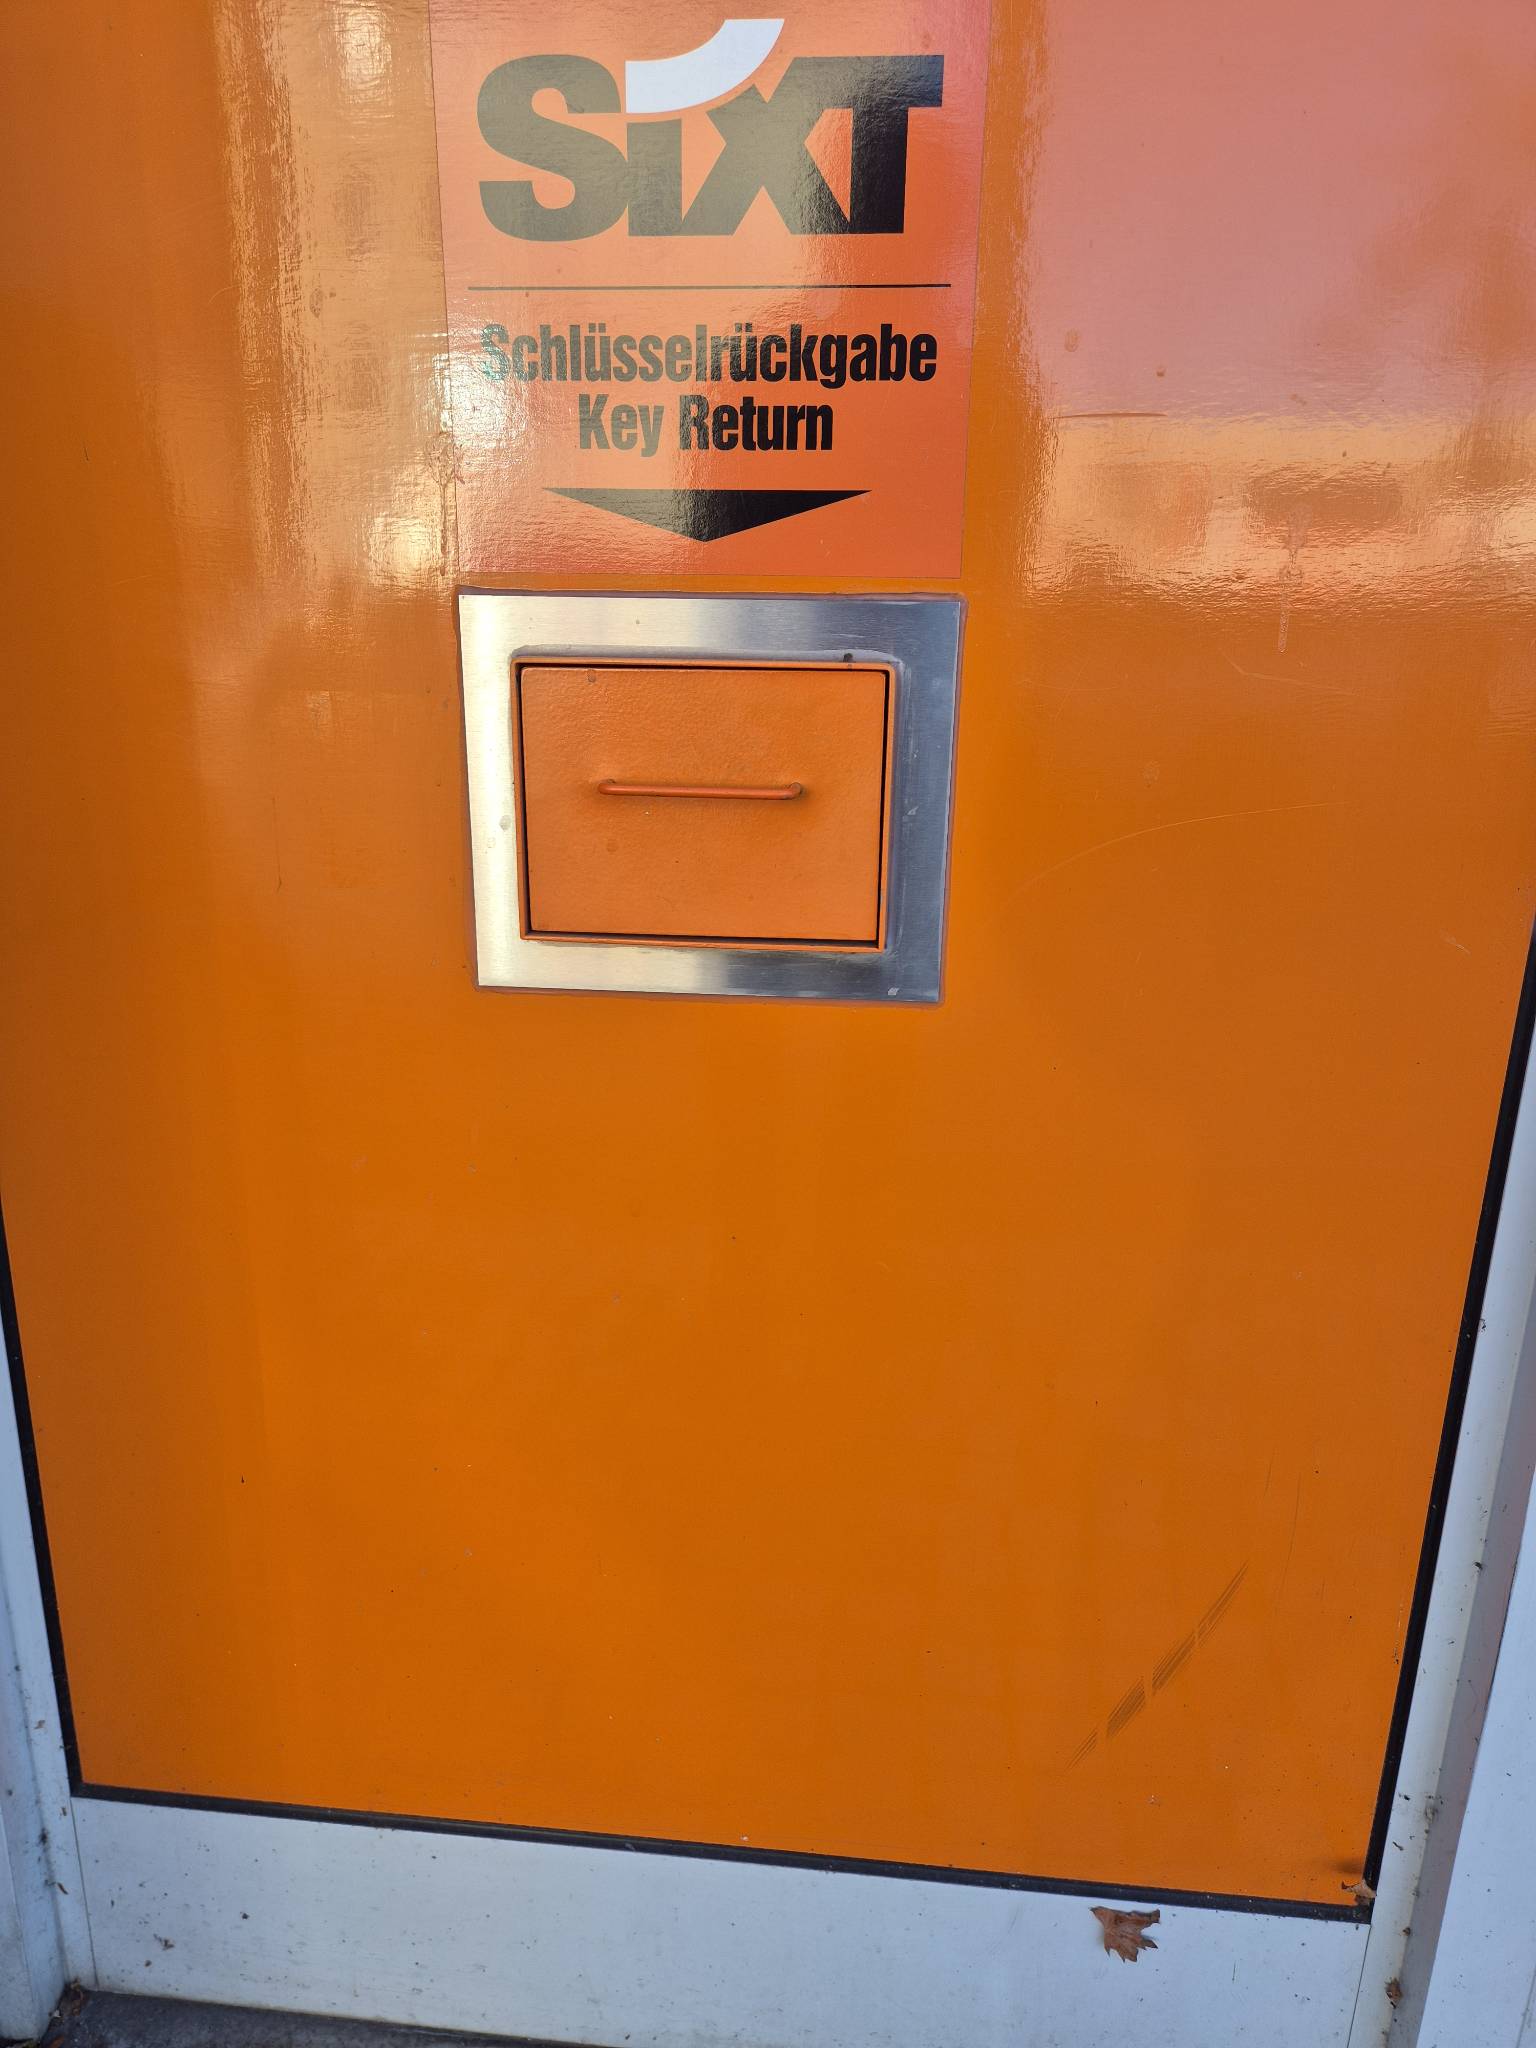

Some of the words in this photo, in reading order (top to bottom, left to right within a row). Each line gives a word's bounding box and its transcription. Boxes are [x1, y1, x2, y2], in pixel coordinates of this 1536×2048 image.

[481, 323, 938, 390] Schlüsselrückgabe
[578, 393, 664, 458] Key
[679, 395, 834, 452] Return
